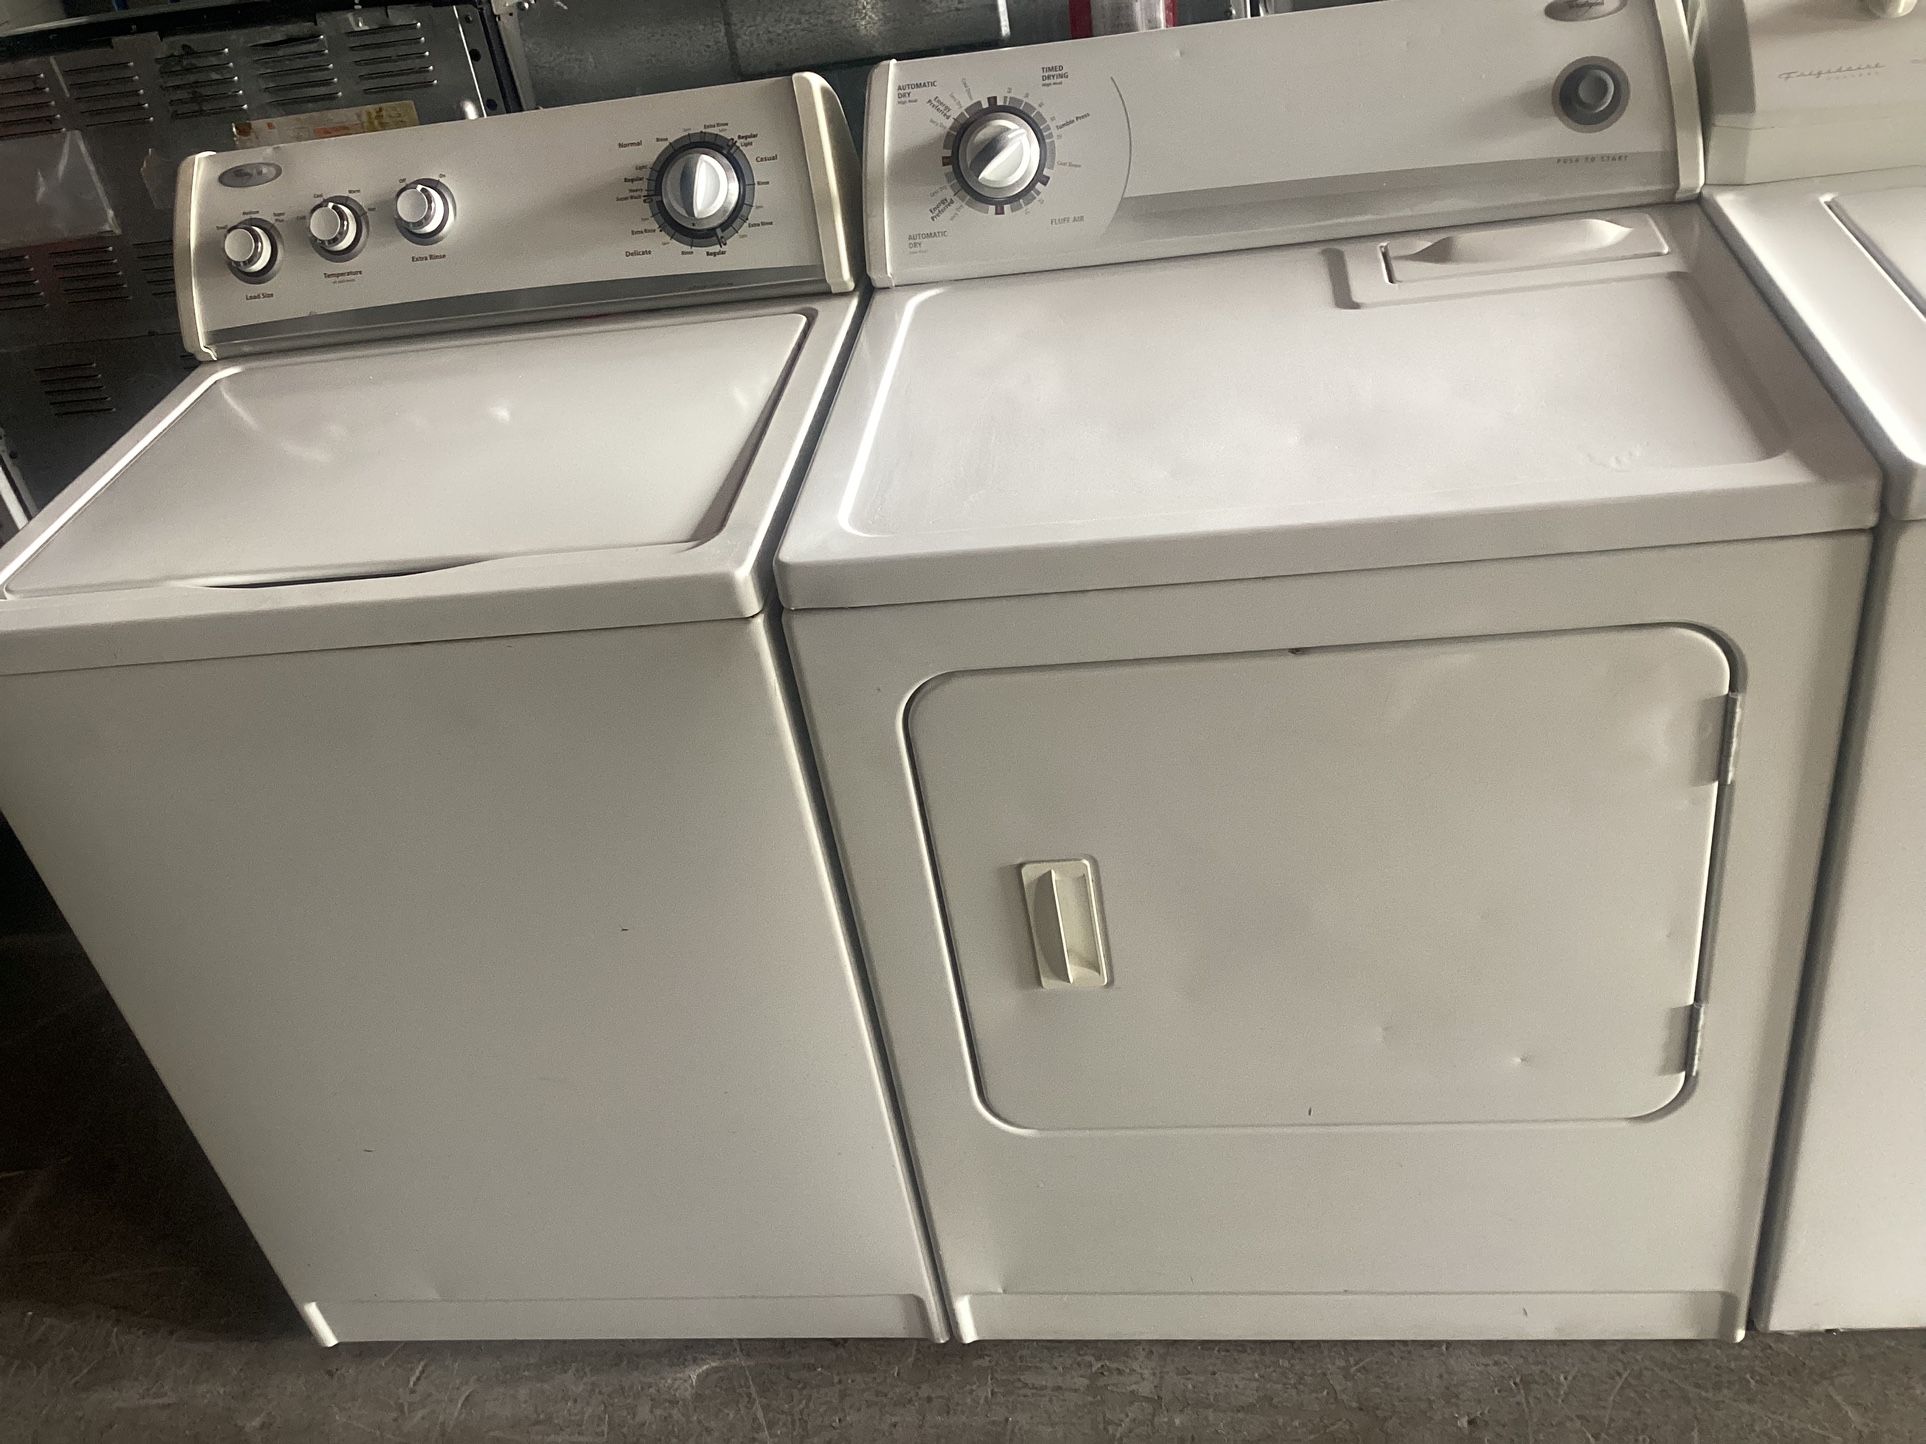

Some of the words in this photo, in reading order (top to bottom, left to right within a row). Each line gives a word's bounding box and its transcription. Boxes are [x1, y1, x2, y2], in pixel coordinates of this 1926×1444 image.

[1041, 65, 1064, 73] TIMED
[1041, 72, 1068, 81] DRYING
[897, 81, 937, 91] AUTOMATIC
[933, 96, 952, 112] Energy
[926, 99, 951, 120] Preferred
[1075, 112, 1090, 122] Press
[618, 140, 642, 148] Normal
[756, 154, 777, 162] Casual
[929, 197, 949, 214] Energy
[931, 198, 955, 222] Preferred
[908, 231, 948, 241] AUTOMATIC
[324, 270, 362, 278] Temperature
